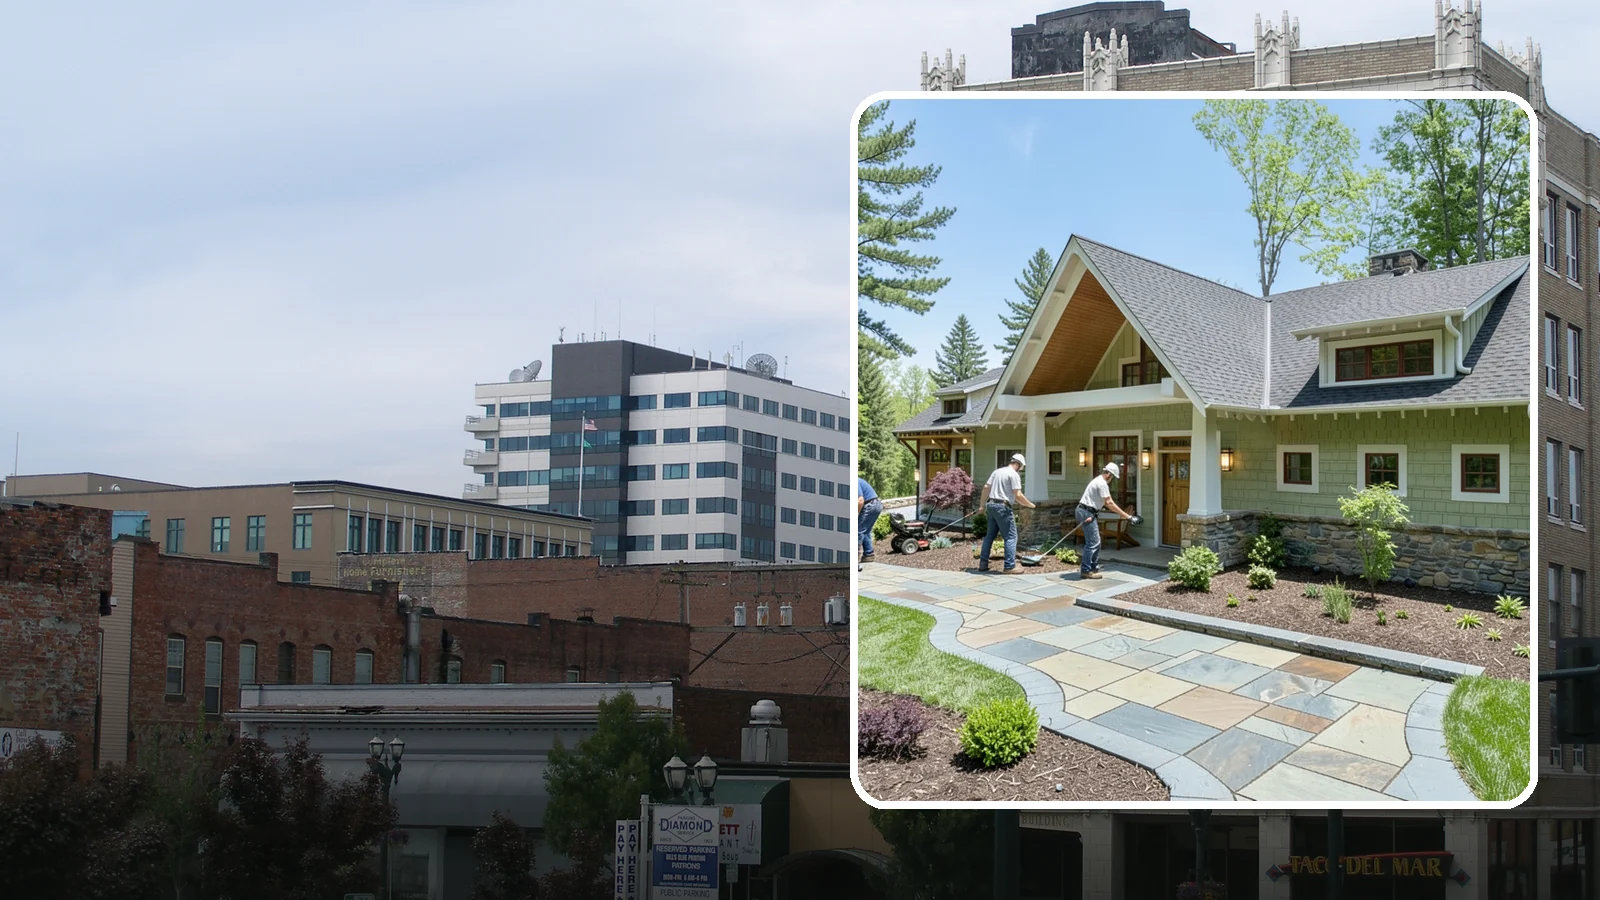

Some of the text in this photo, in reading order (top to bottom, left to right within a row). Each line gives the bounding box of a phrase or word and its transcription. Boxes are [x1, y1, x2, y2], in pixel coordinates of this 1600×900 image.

[370, 566, 427, 577] Furnishers
[660, 818, 713, 832] DIAMOND
[1022, 815, 1070, 827] BUILDING
[617, 825, 625, 852] PAY
[628, 825, 636, 852] PAY
[656, 845, 716, 854] RESERVED PARKING
[722, 851, 739, 862] Soup
[671, 862, 701, 870] PATRONS
[1346, 856, 1385, 876] DEL
[1392, 857, 1443, 877] MAR
[616, 856, 625, 894] HERE
[628, 856, 636, 893] HERE
[660, 889, 710, 898] PUBLIC PARKING
